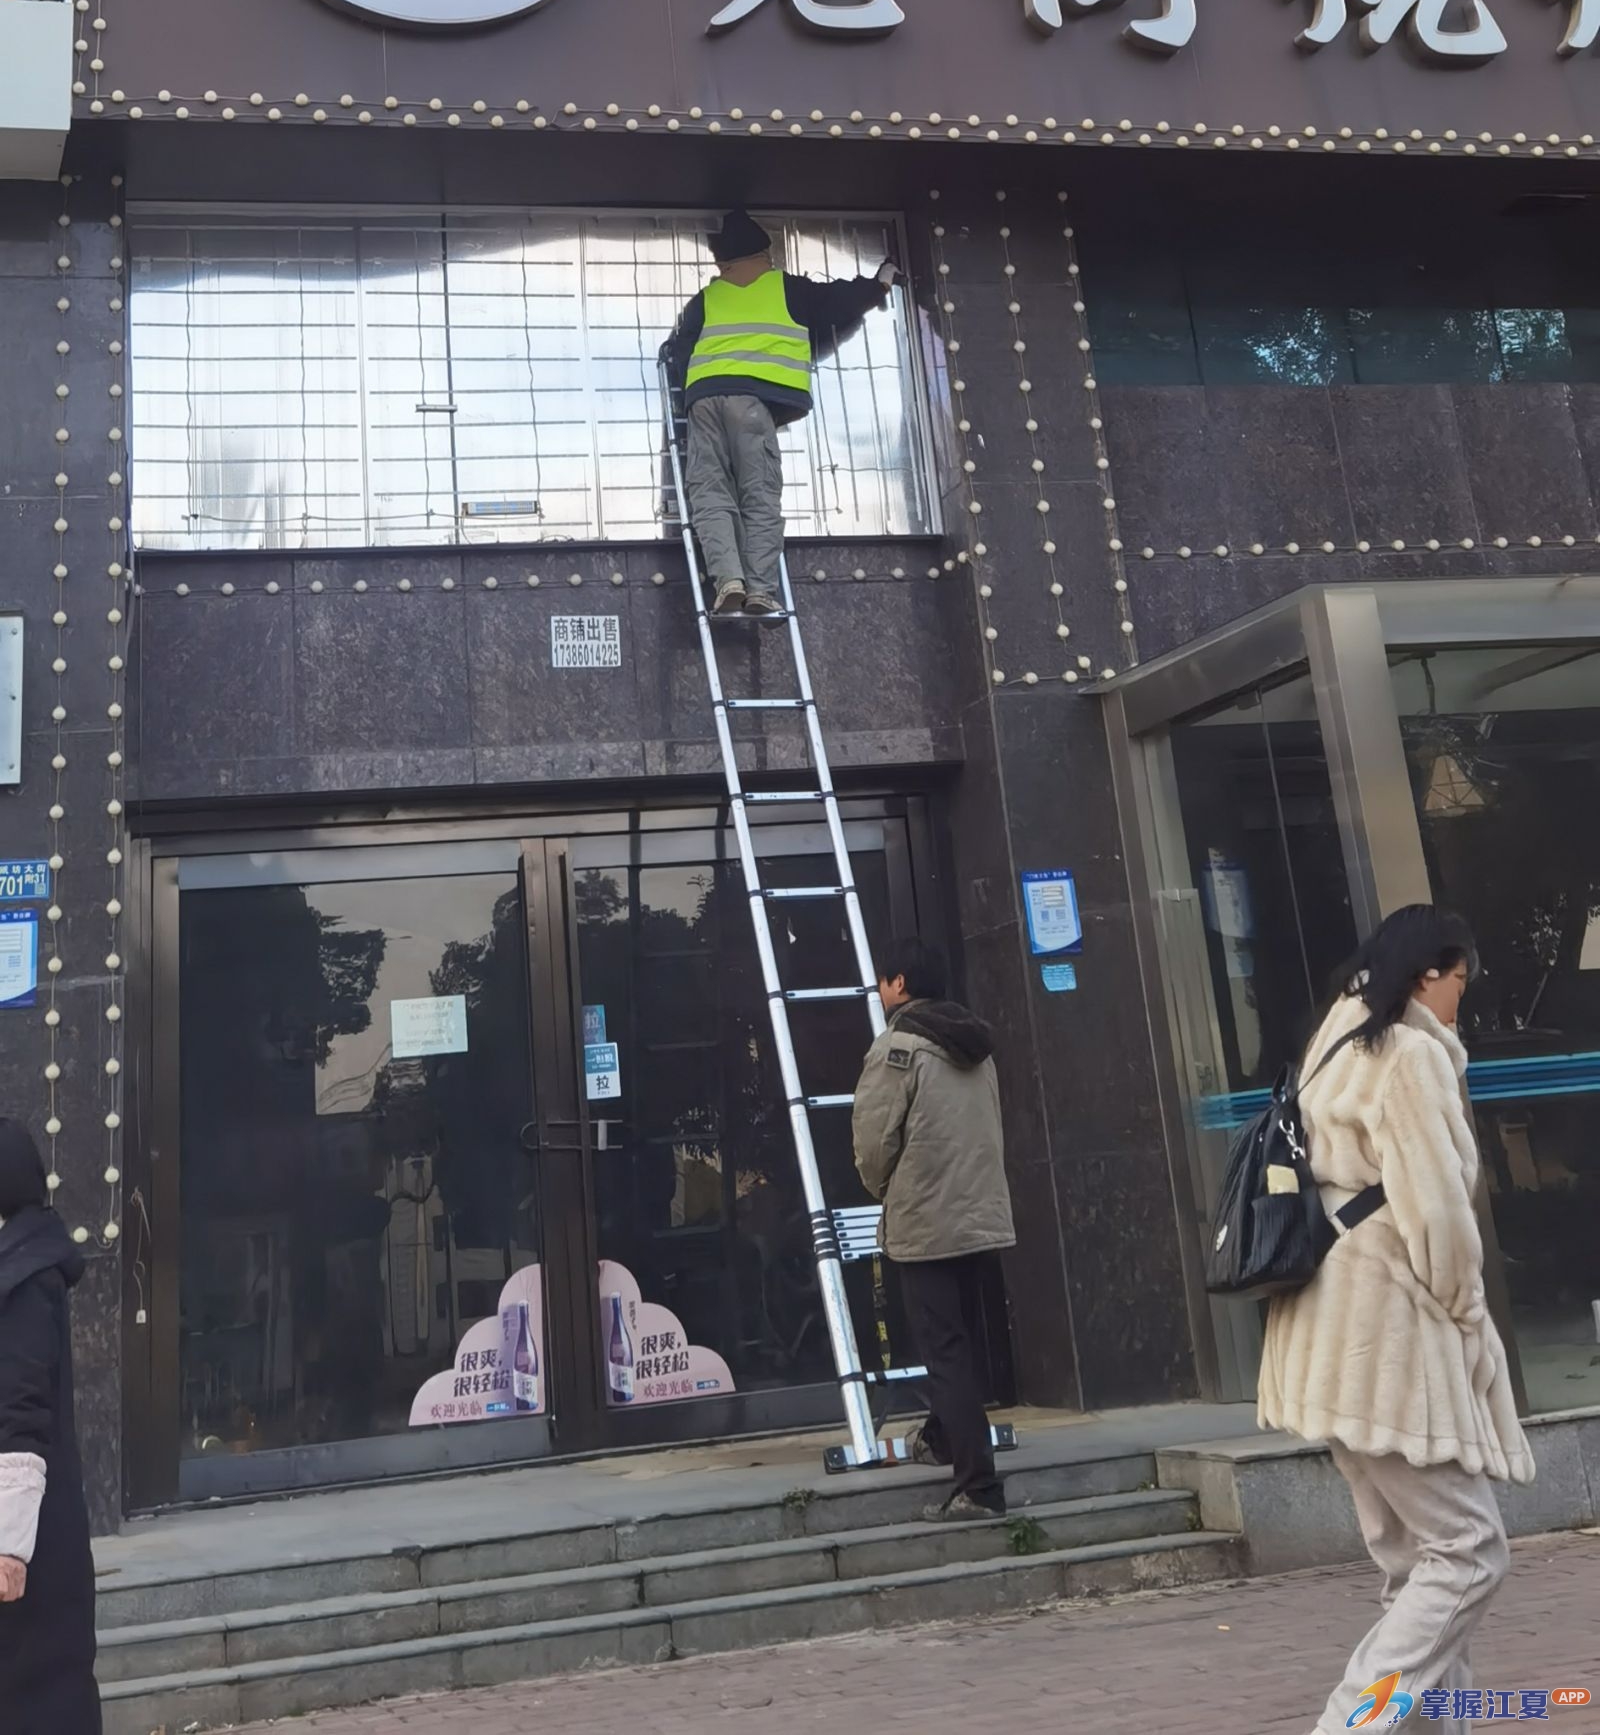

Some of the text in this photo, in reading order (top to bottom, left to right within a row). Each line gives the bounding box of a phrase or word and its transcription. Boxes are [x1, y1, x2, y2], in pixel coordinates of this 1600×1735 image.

[554, 617, 617, 642] 商铺出售
[554, 644, 619, 666] 17386014225
[596, 1074, 610, 1091] 拉
[636, 1351, 690, 1380] 很轻松
[453, 1369, 511, 1397] 很轻松
[644, 1379, 694, 1398] 欢迎光临
[431, 1400, 482, 1419] 欢迎光临
